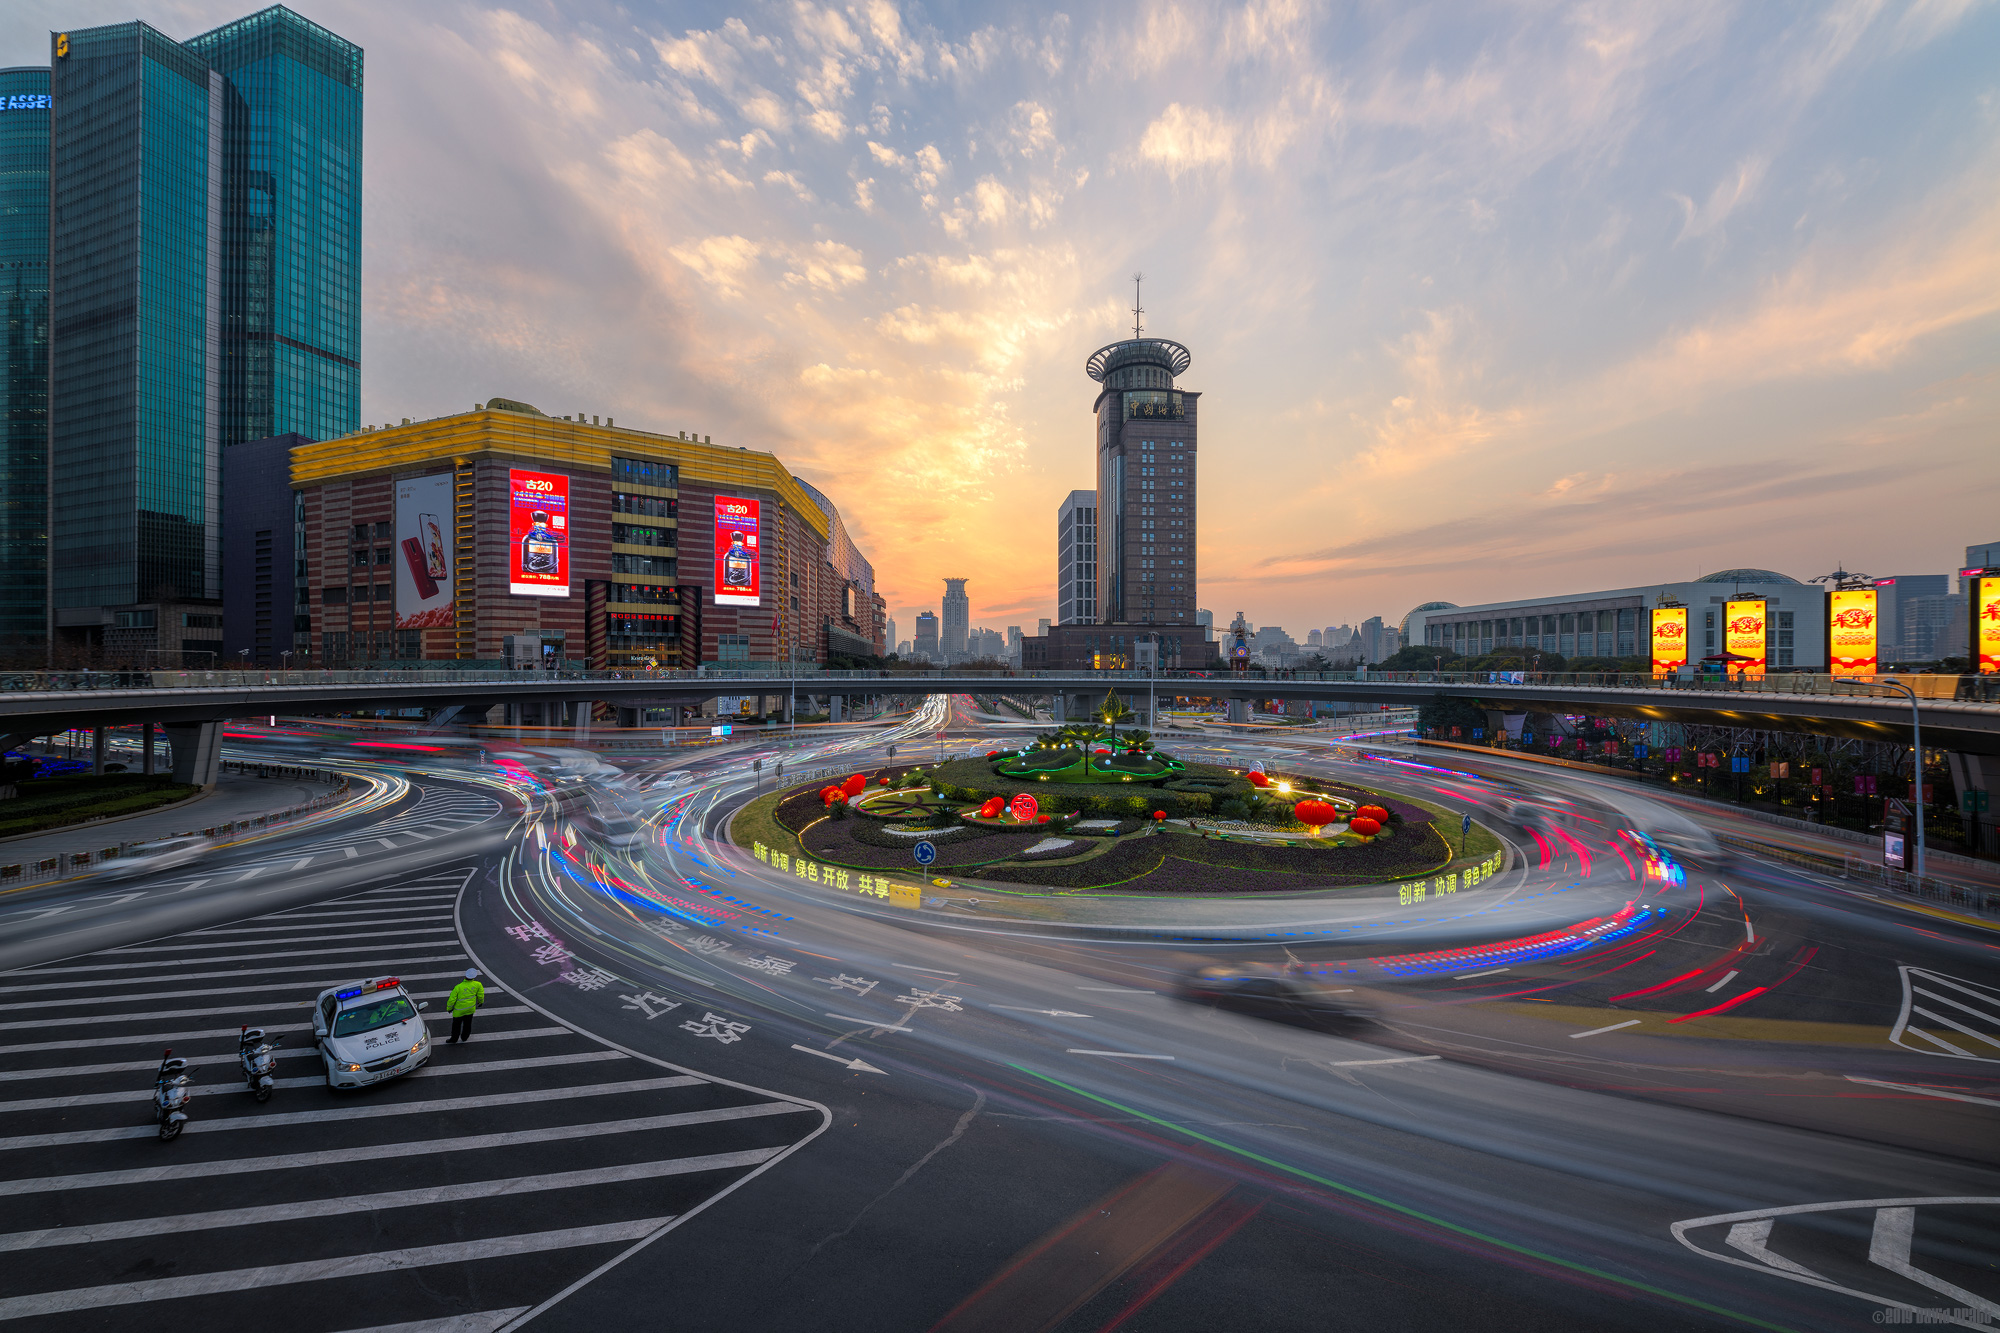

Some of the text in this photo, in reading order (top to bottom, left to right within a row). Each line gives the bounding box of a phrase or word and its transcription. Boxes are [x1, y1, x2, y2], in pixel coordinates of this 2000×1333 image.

[526, 480, 553, 491] 古20
[727, 504, 747, 514] 古20
[1727, 617, 1764, 634] 年货节
[1831, 610, 1875, 629] 年货节
[1653, 624, 1685, 638] 年货节
[1012, 795, 1037, 820] 福
[754, 841, 890, 898] 创新 协调 绿色 开放 共享
[1399, 881, 1426, 905] 创新
[1435, 874, 1457, 898] 协调
[366, 1037, 400, 1050] POLICE
